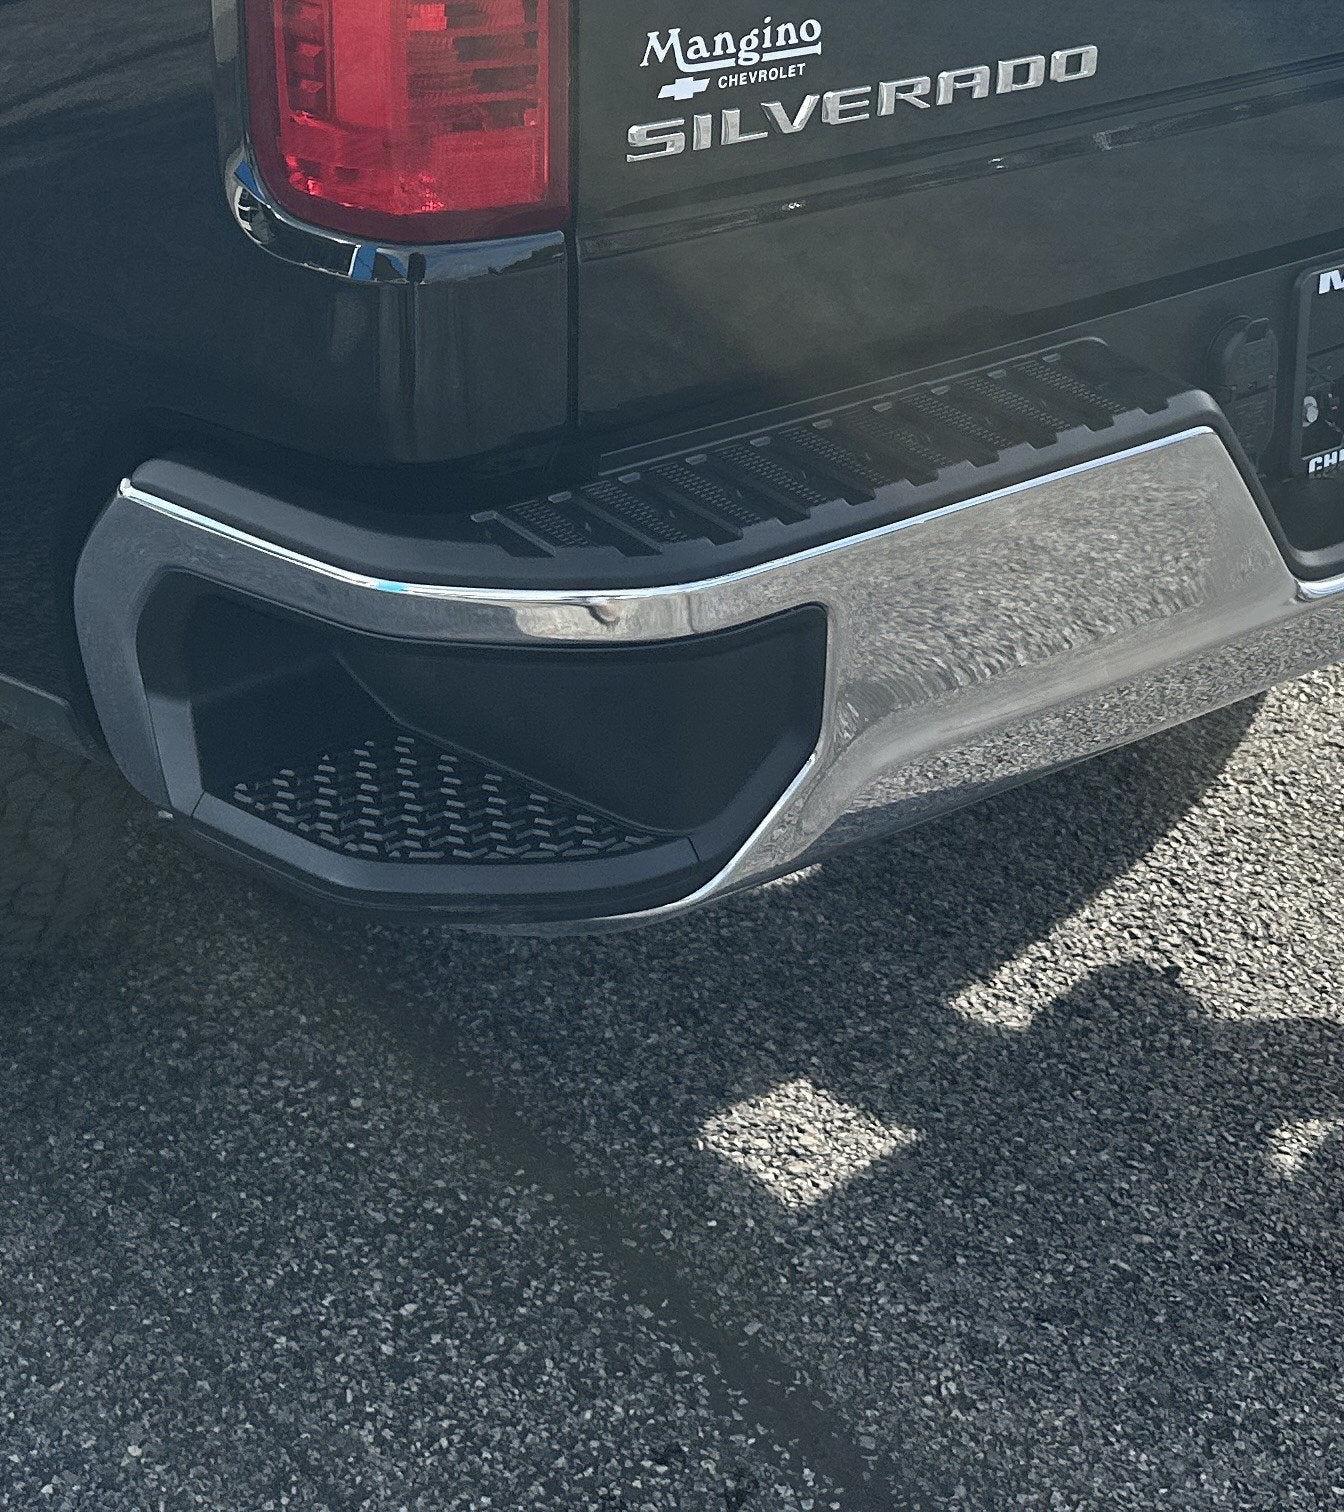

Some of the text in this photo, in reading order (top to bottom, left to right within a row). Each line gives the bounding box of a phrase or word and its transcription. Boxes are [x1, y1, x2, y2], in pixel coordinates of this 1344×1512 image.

[639, 16, 822, 73] Mangino
[626, 44, 1099, 163] SILVERADO
[717, 62, 807, 90] CHEVROLET
